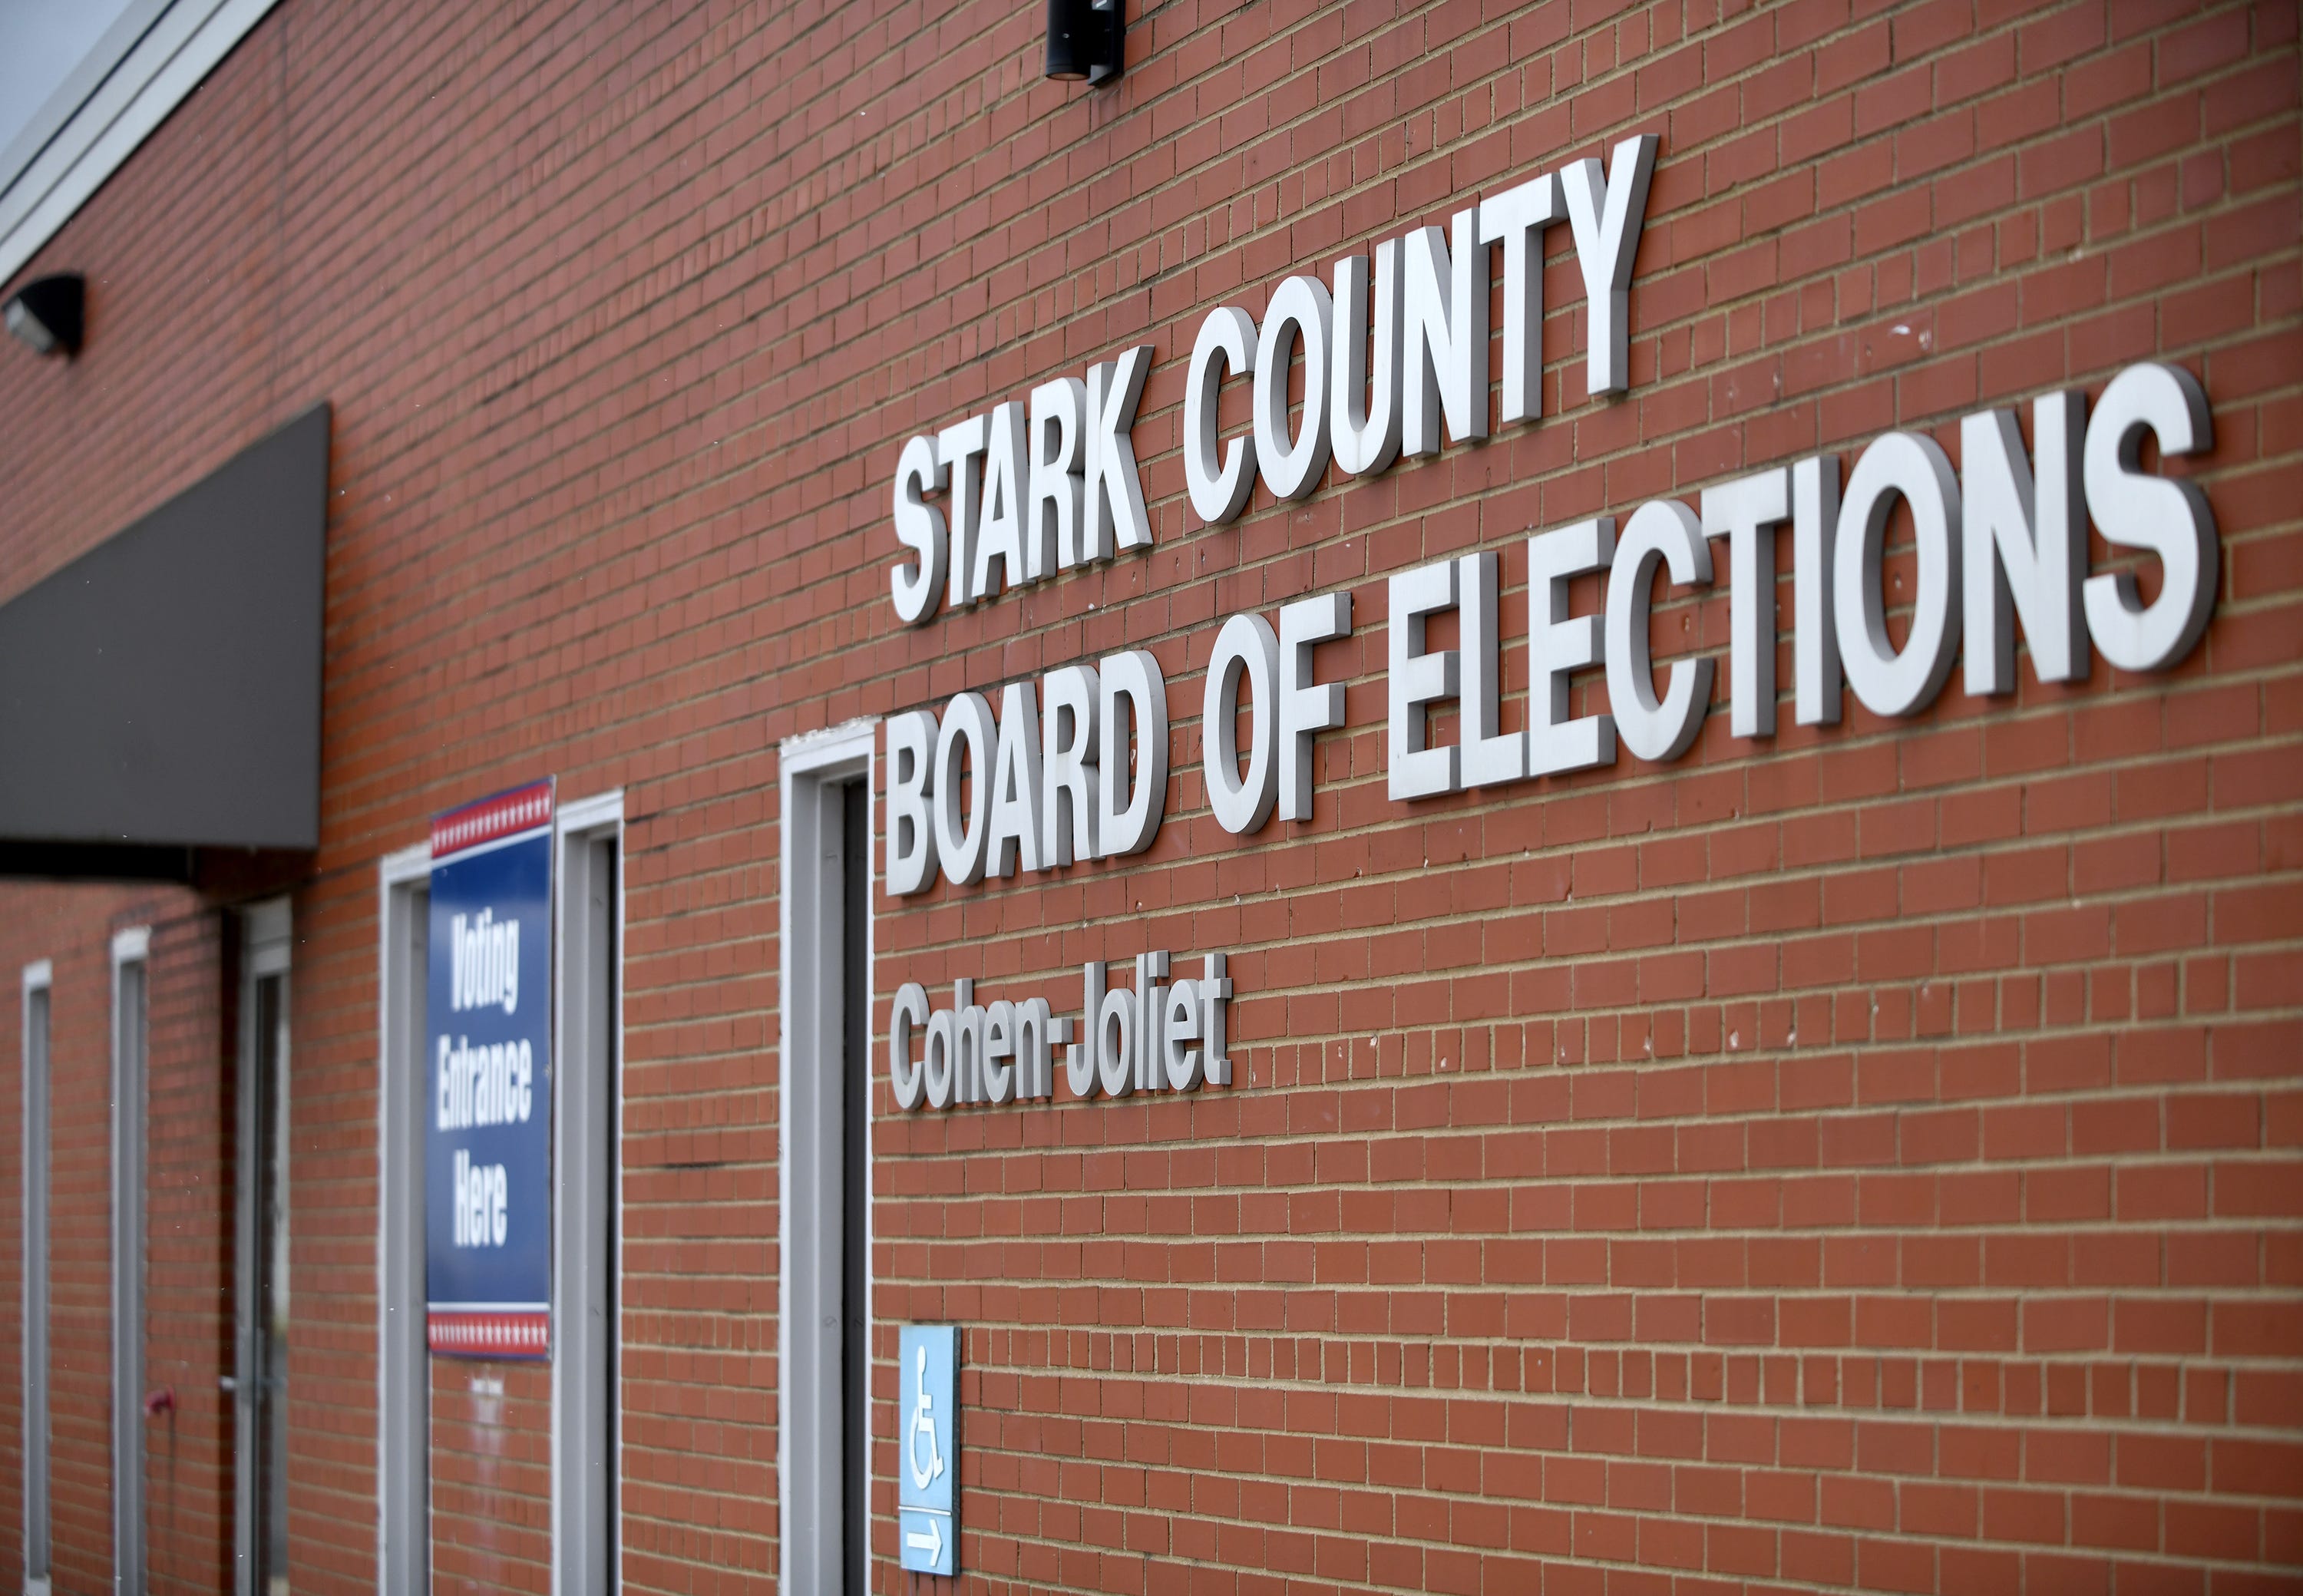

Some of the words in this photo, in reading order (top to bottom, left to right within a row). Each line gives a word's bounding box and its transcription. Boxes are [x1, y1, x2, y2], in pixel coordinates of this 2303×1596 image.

[891, 344, 1155, 623] STARK
[1183, 133, 1660, 524] COUNTY
[886, 649, 1168, 897] BOARD
[1203, 591, 1352, 835] OF
[1387, 362, 2219, 802] ELECTIONS
[451, 907, 520, 1015] Voting
[436, 1033, 533, 1132] Entrance
[890, 950, 1233, 1110] Cohen-Joliet
[453, 1150, 507, 1248] Here
